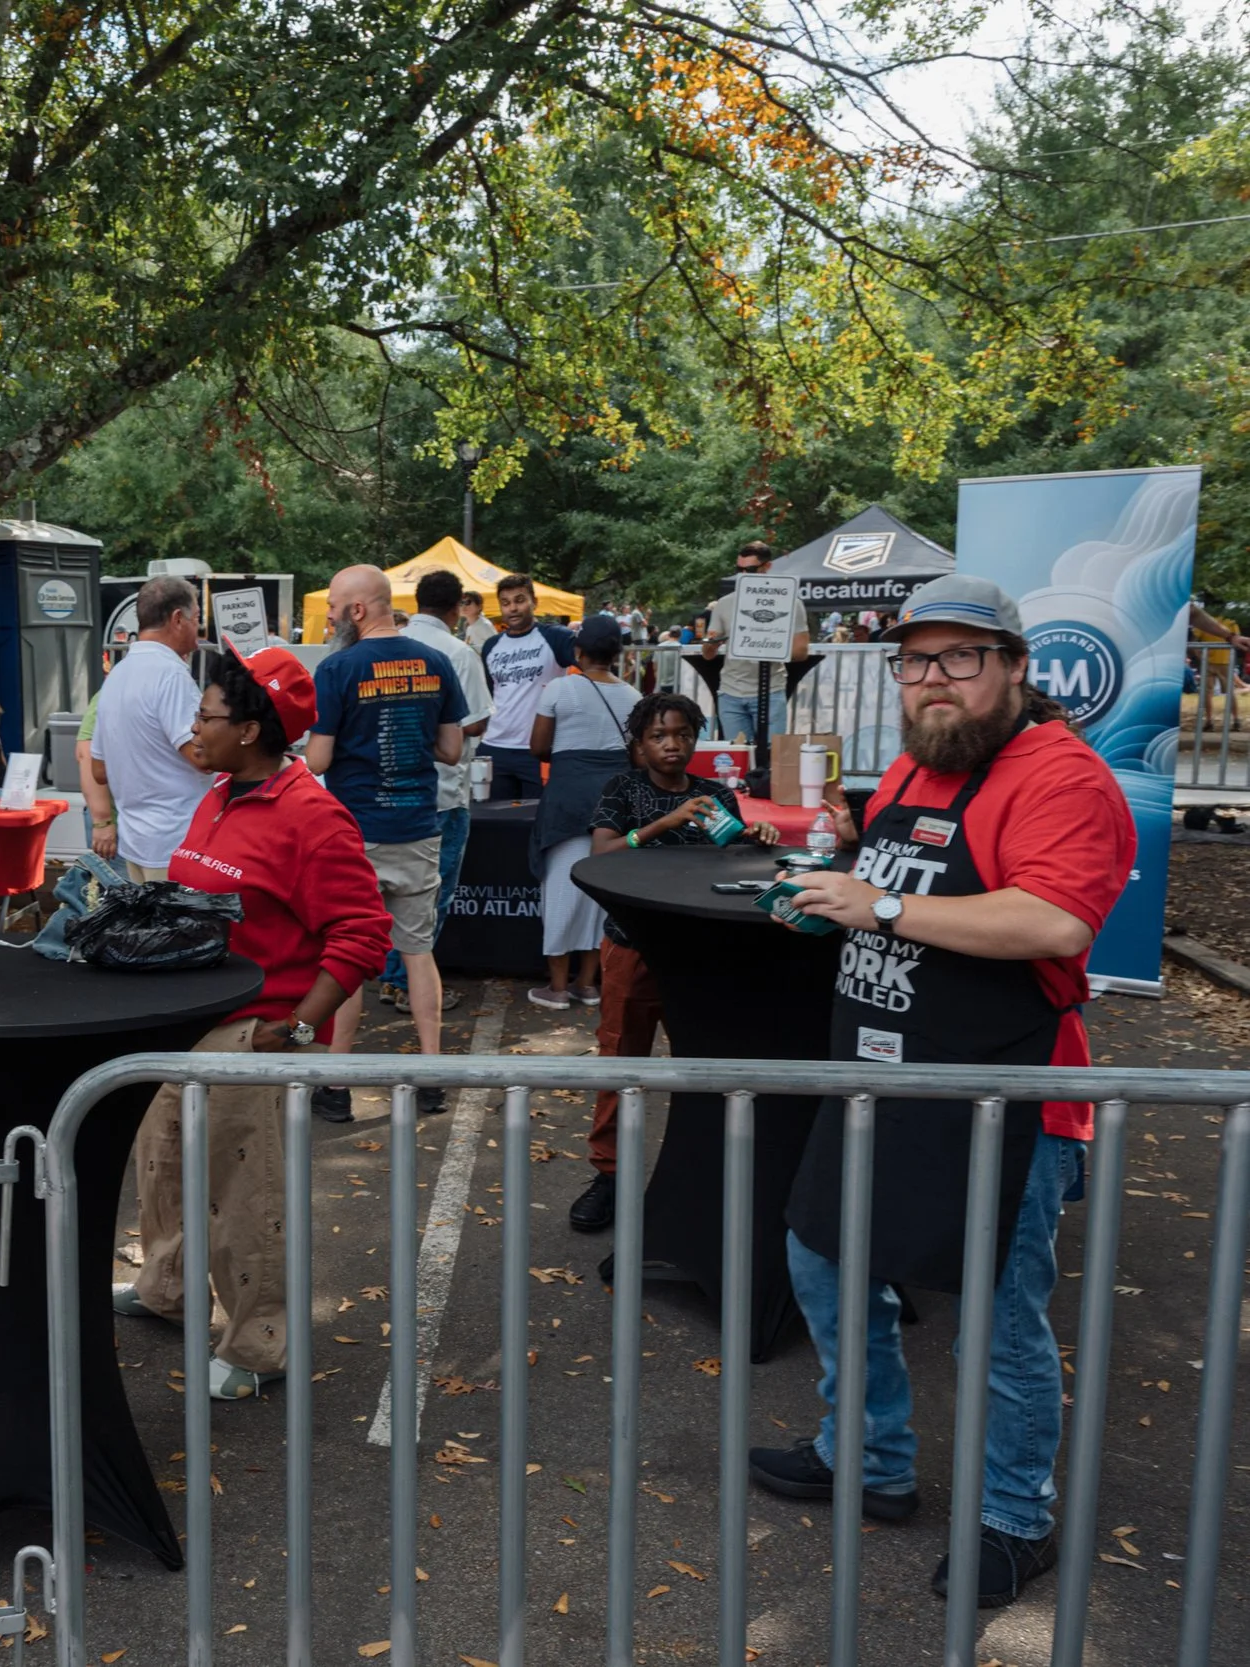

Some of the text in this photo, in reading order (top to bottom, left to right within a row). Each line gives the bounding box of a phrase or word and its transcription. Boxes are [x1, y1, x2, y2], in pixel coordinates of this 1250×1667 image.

[746, 586, 789, 596] PARKING
[221, 600, 256, 611] PARKING
[756, 598, 776, 607] FOR
[231, 612, 249, 620] FOR
[491, 644, 544, 669] Highland
[491, 665, 544, 685] Mortgage
[1027, 659, 1091, 697] HM
[173, 848, 244, 880] OMMY HILFIGER
[853, 847, 949, 896] BUTT
[446, 899, 542, 917] TRO ATLAN
[852, 930, 888, 951] AND
[890, 940, 927, 960] MY
[840, 942, 922, 994] ORK
